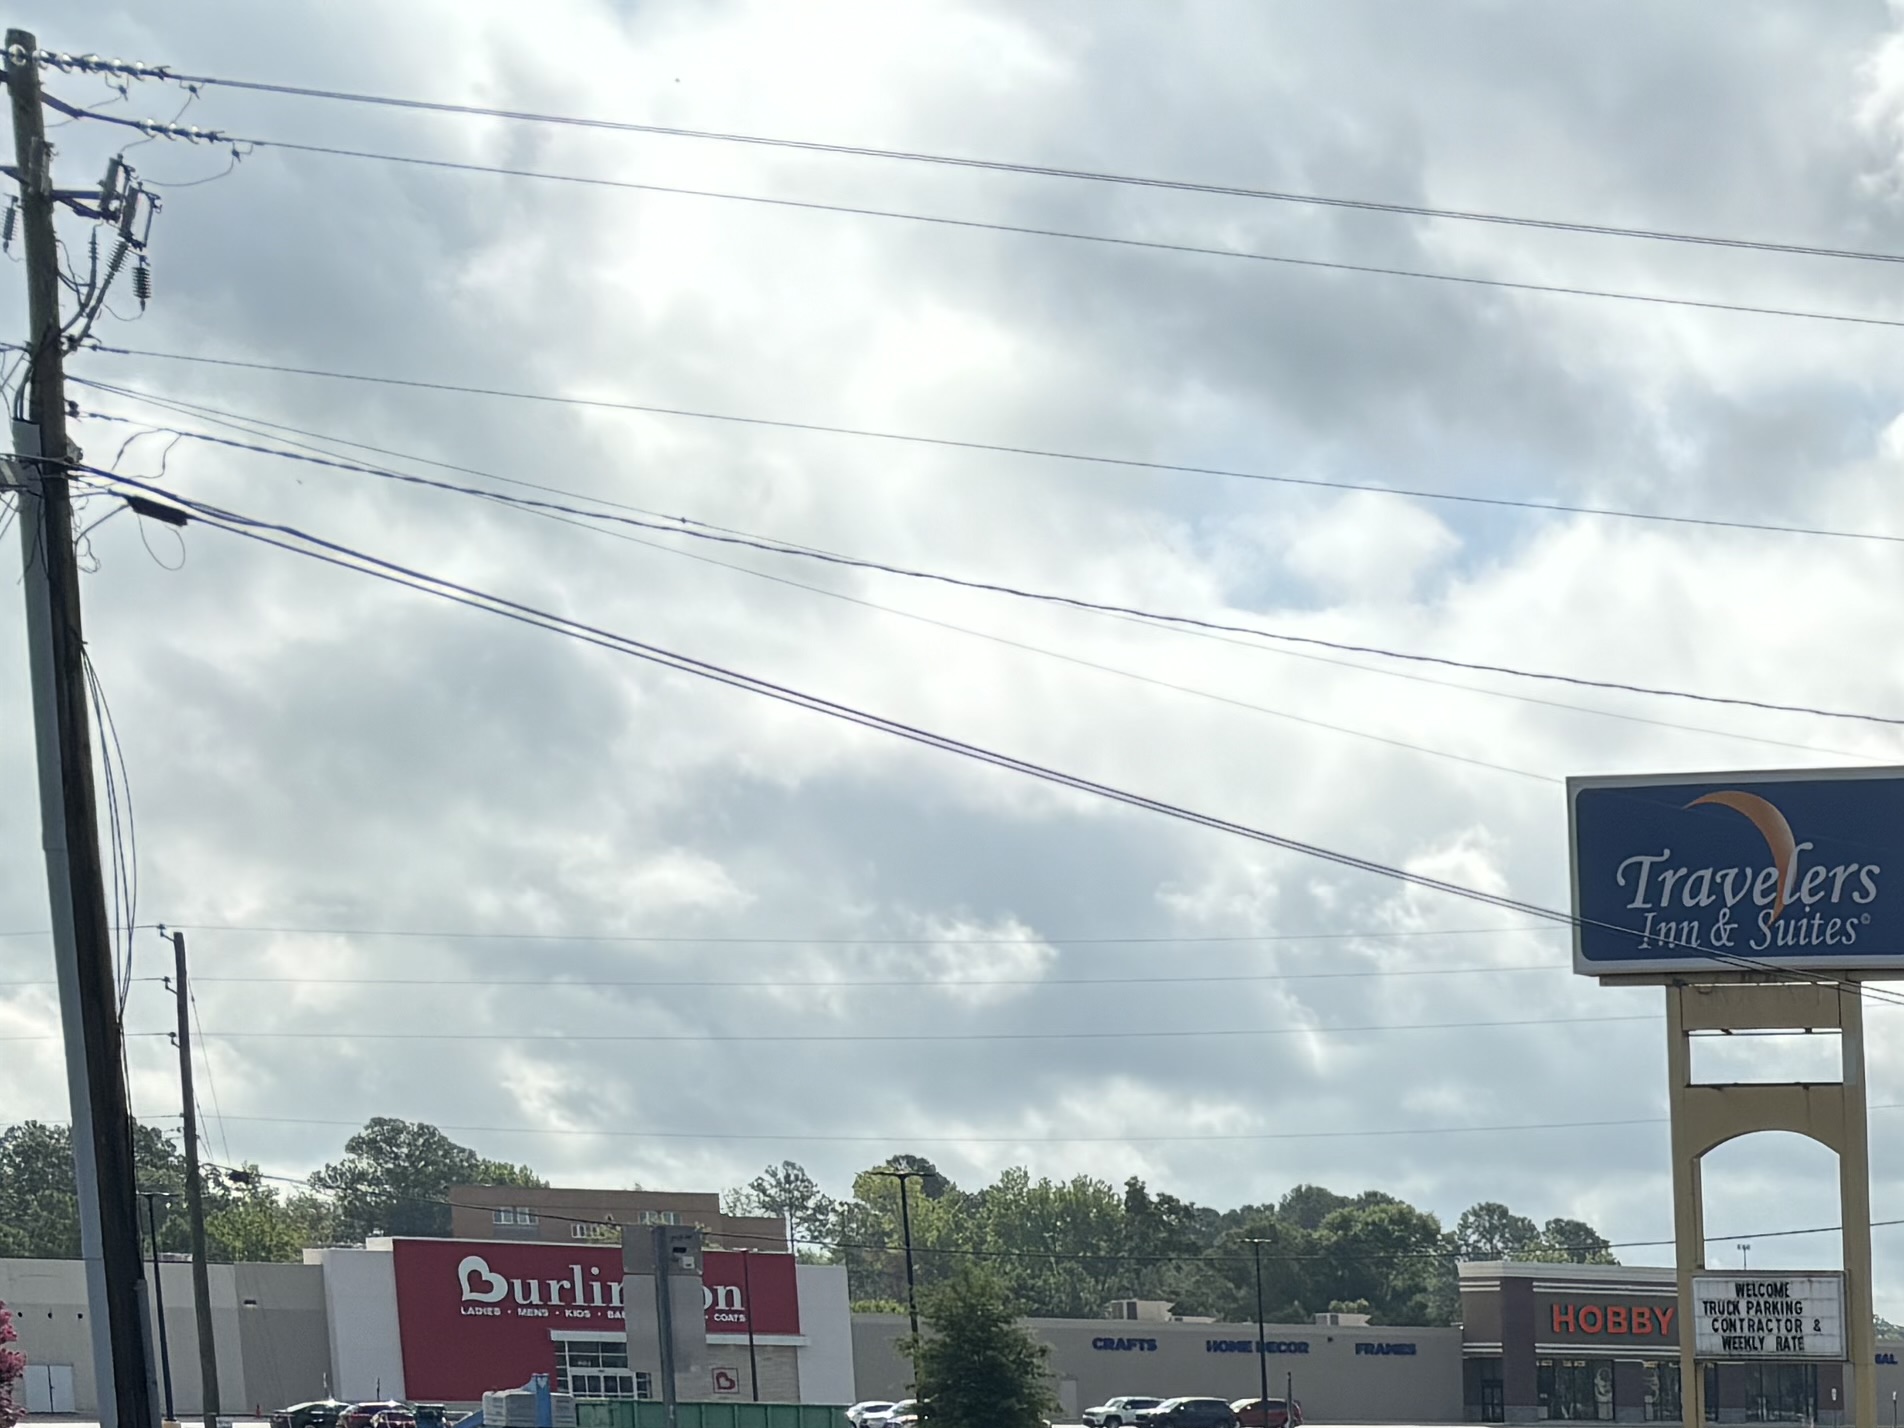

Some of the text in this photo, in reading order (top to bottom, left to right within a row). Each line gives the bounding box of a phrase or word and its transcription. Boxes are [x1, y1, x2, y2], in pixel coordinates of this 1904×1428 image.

[1616, 842, 1881, 909] Travelers
[1637, 906, 1859, 950] Inn & Suites
[1735, 1282, 1790, 1298] WELCOME
[460, 1306, 501, 1316] LADIES
[565, 1309, 591, 1318] KIDS
[714, 1313, 746, 1322] COATS
[1702, 1301, 1803, 1316] TRUCK PARKING
[1552, 1303, 1674, 1336] HOBBY
[1712, 1318, 1803, 1333] CONTRACTOR
[1092, 1337, 1158, 1351] CRAFTS
[1722, 1336, 1805, 1351] WEEKLY RATE
